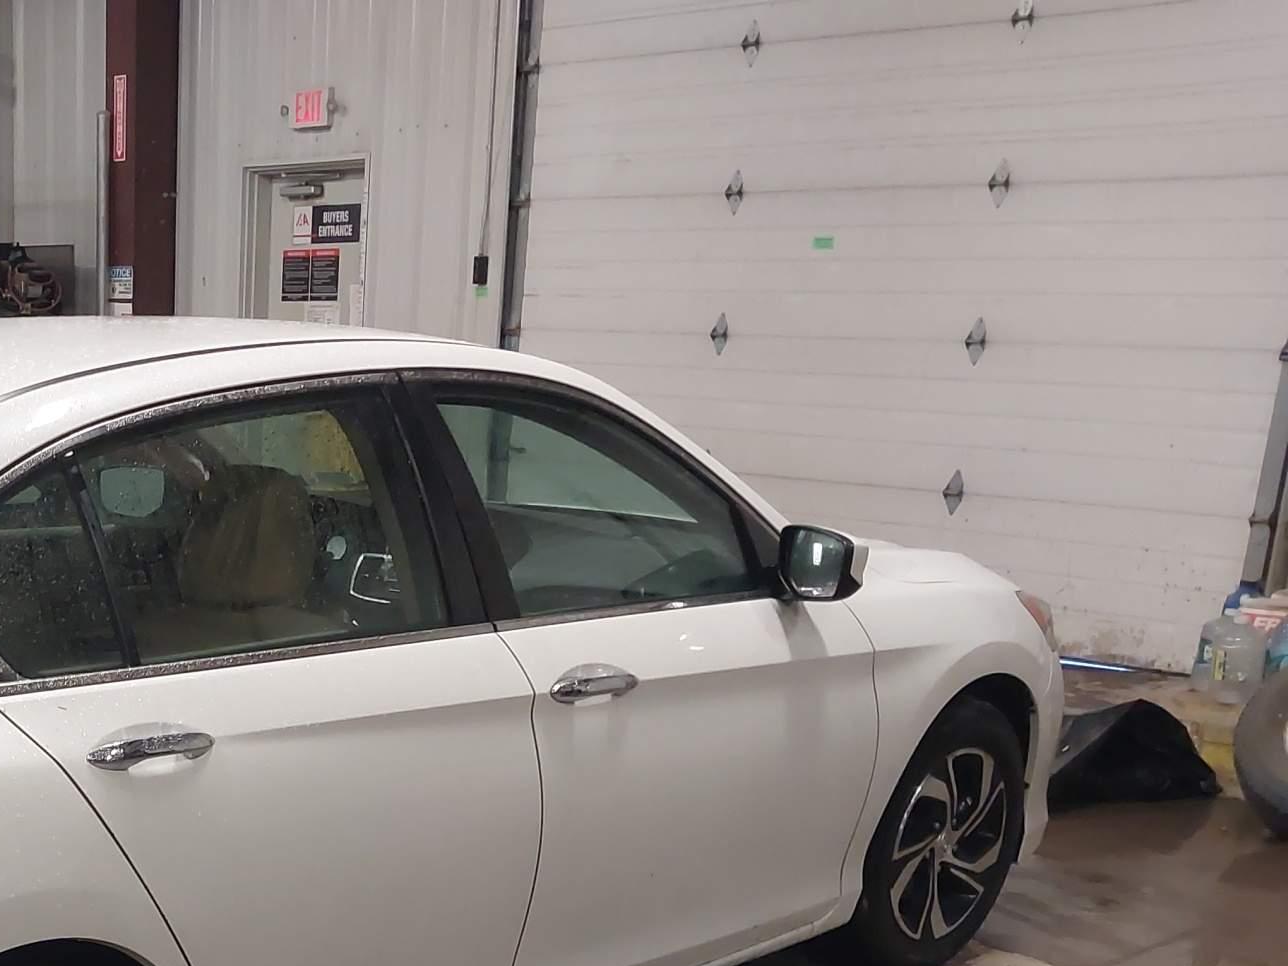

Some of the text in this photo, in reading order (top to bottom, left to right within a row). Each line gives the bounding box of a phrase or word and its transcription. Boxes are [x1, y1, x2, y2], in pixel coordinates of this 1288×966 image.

[295, 90, 322, 123] EXIT
[323, 210, 349, 223] BUYERS
[318, 224, 353, 237] ENTRANCE
[110, 267, 132, 278] OTICE
